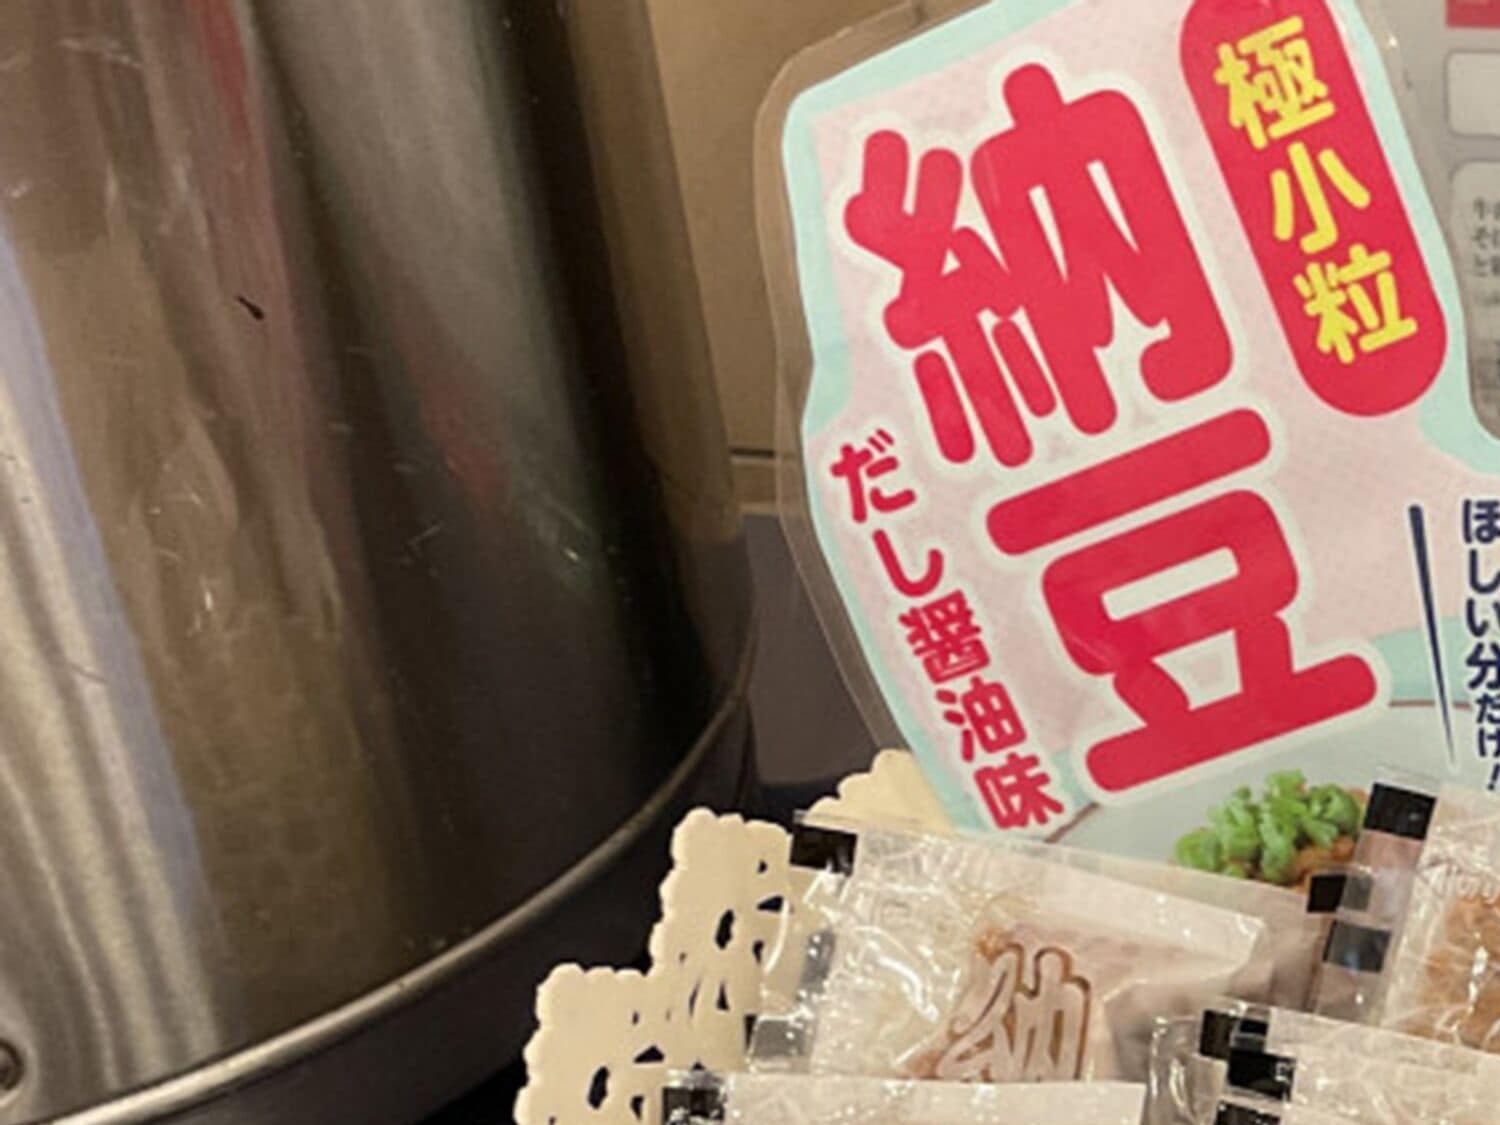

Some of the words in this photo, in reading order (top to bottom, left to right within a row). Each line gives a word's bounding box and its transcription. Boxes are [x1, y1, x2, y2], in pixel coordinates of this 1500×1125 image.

[1214, 15, 1419, 365] 極小粒
[830, 427, 1063, 831] だし醤油味
[843, 62, 1378, 793] 納豆
